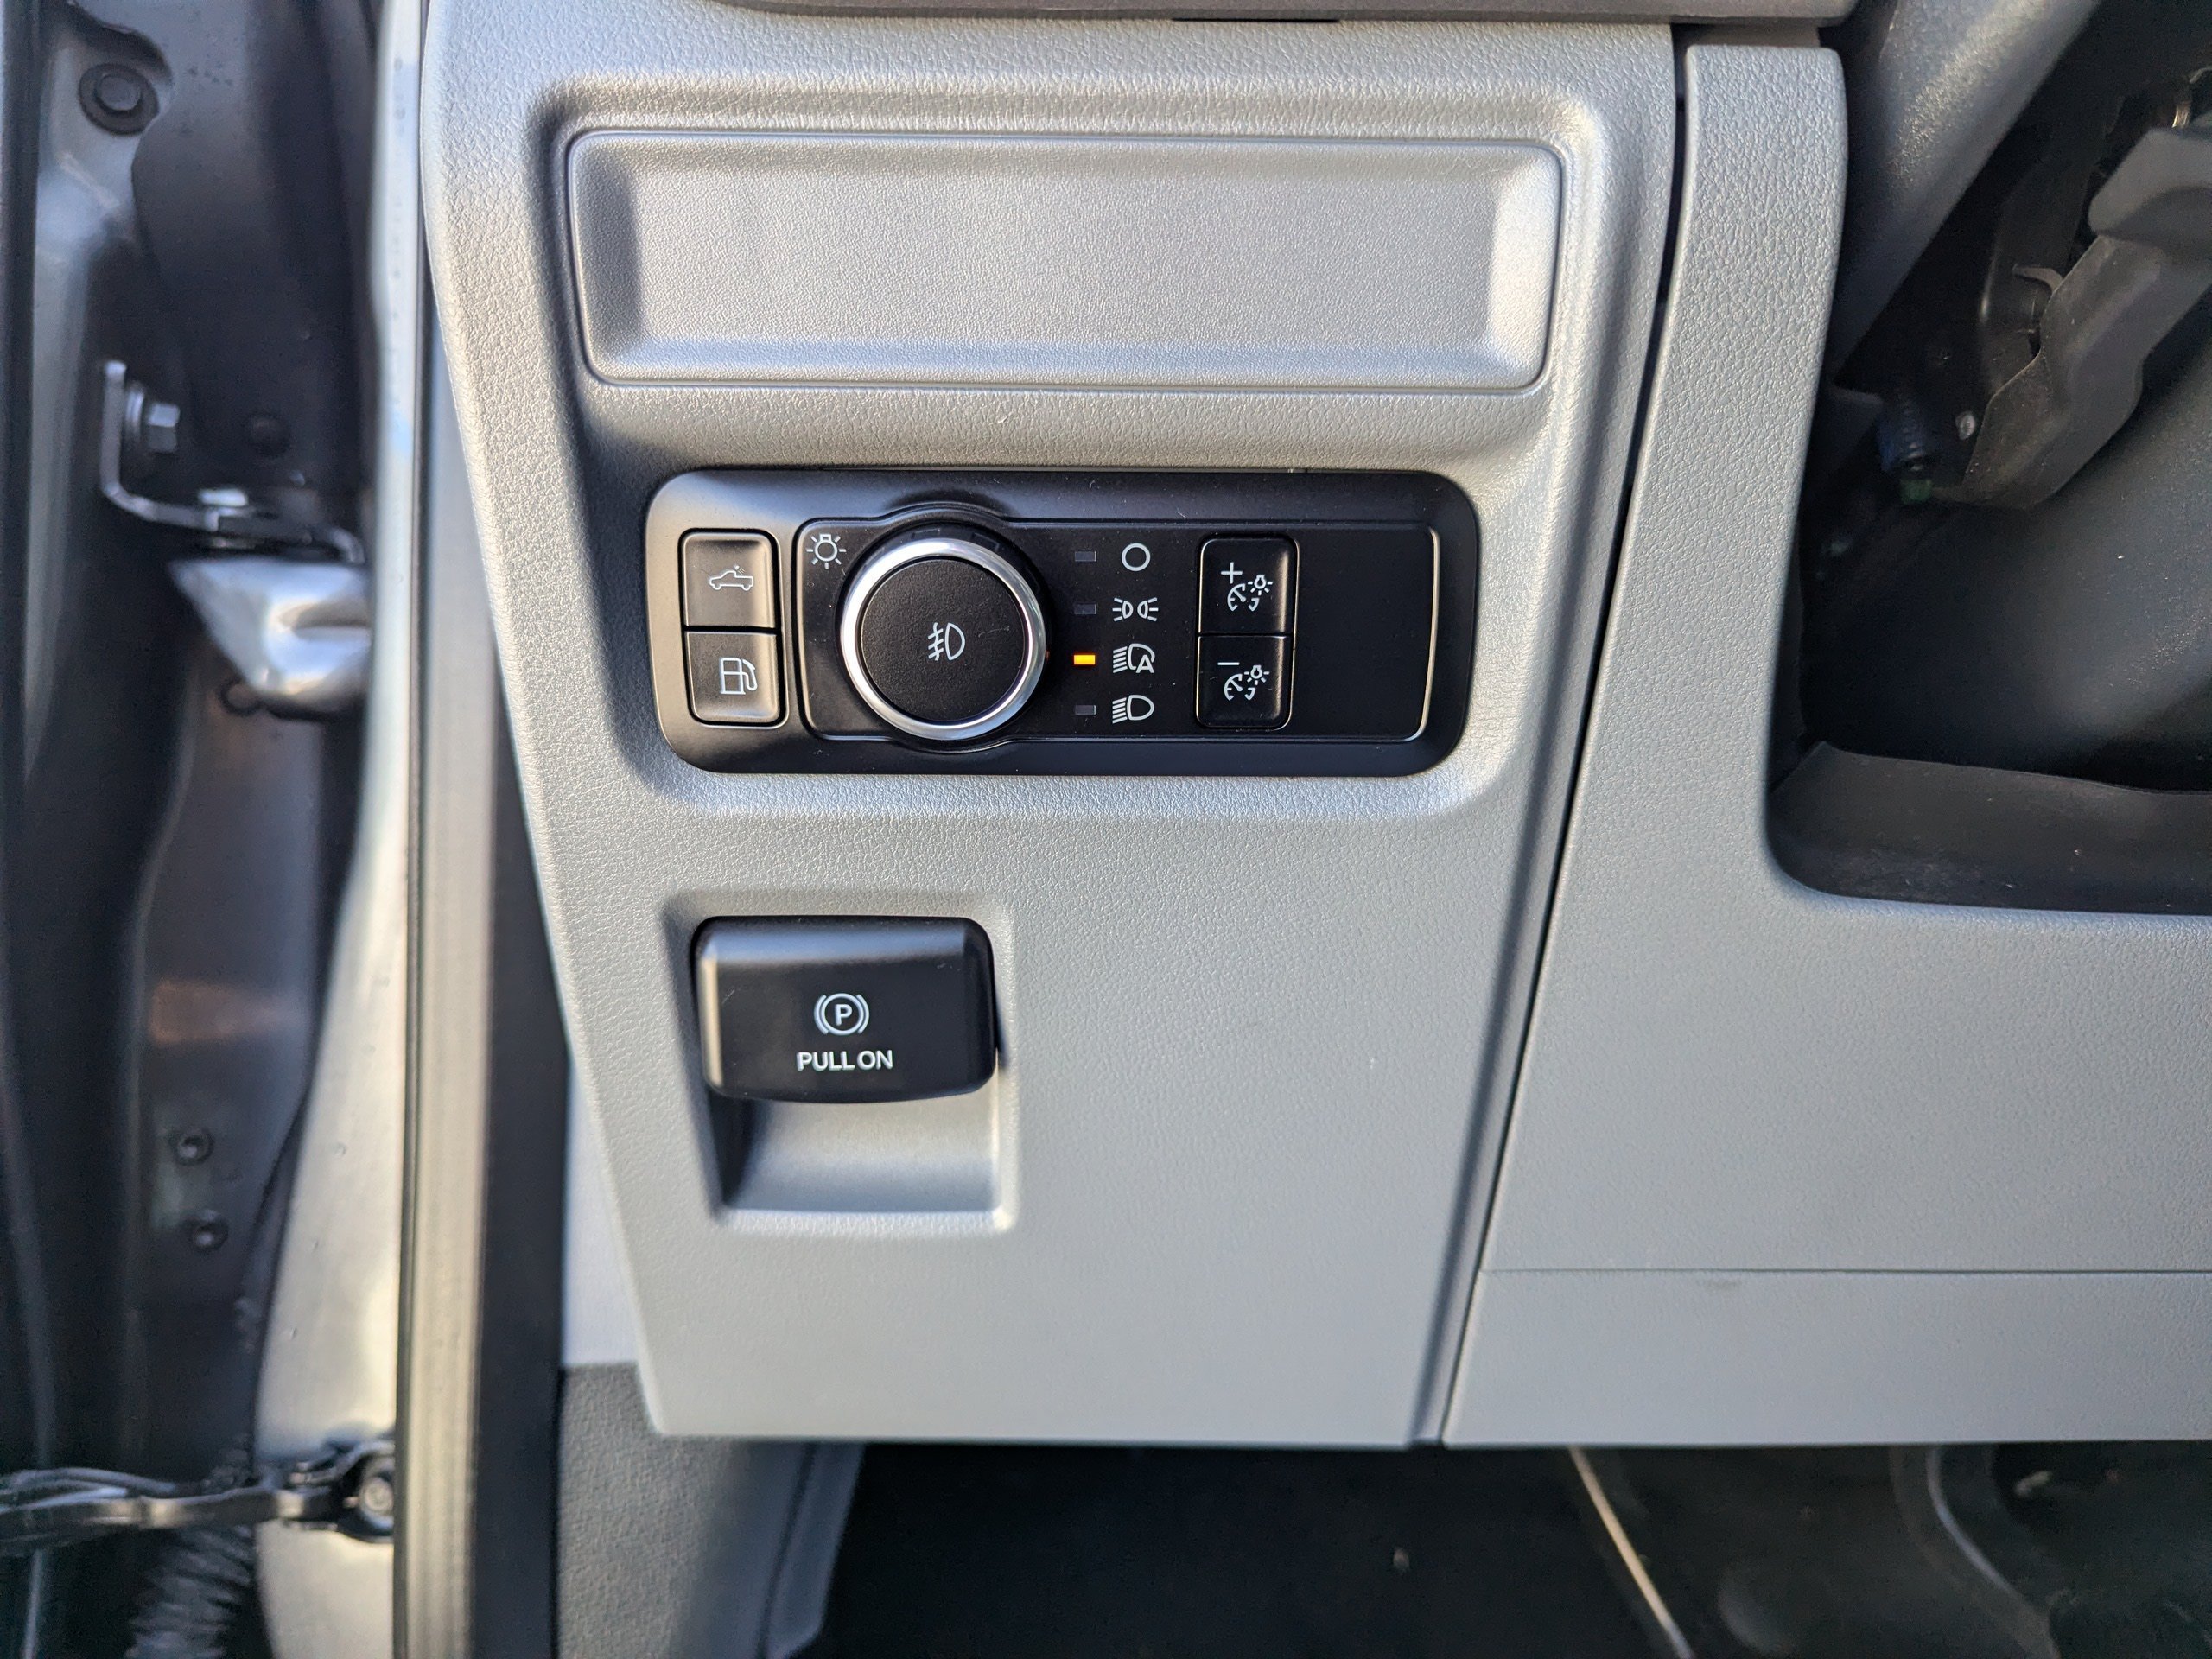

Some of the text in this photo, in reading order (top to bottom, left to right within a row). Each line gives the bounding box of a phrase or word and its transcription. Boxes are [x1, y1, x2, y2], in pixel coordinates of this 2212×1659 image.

[835, 1003, 853, 1027] P
[796, 1049, 893, 1072] PULL ON
